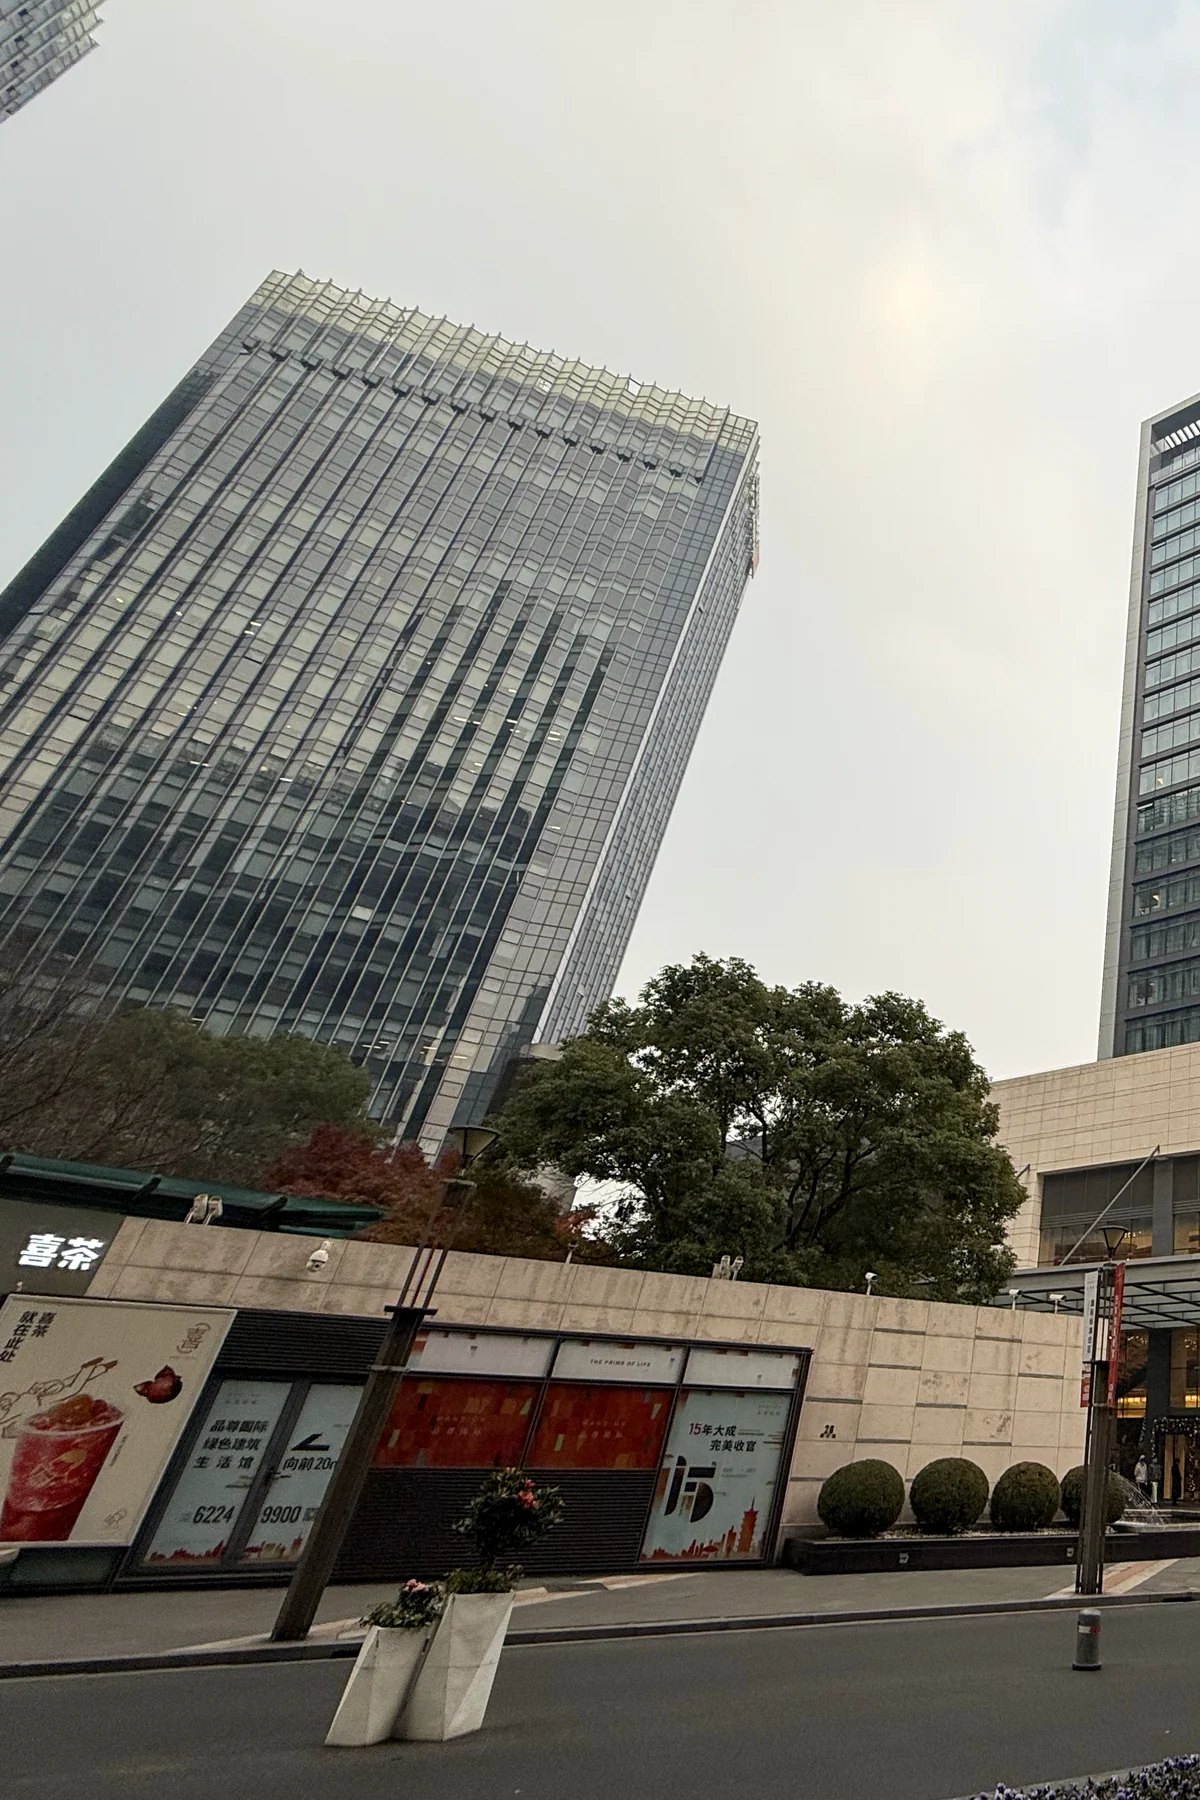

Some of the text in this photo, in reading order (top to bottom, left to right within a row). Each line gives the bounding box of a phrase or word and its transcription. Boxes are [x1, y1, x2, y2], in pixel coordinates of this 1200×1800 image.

[18, 1233, 104, 1271] 喜茶
[0, 1310, 38, 1362] 就在此处
[689, 1422, 738, 1437] 15年大成
[202, 1436, 262, 1451] 绿色建筑
[709, 1439, 757, 1453] 完美收官
[193, 1455, 255, 1469] 生活馆
[192, 1505, 236, 1524] 6224
[260, 1505, 302, 1524] 9900
